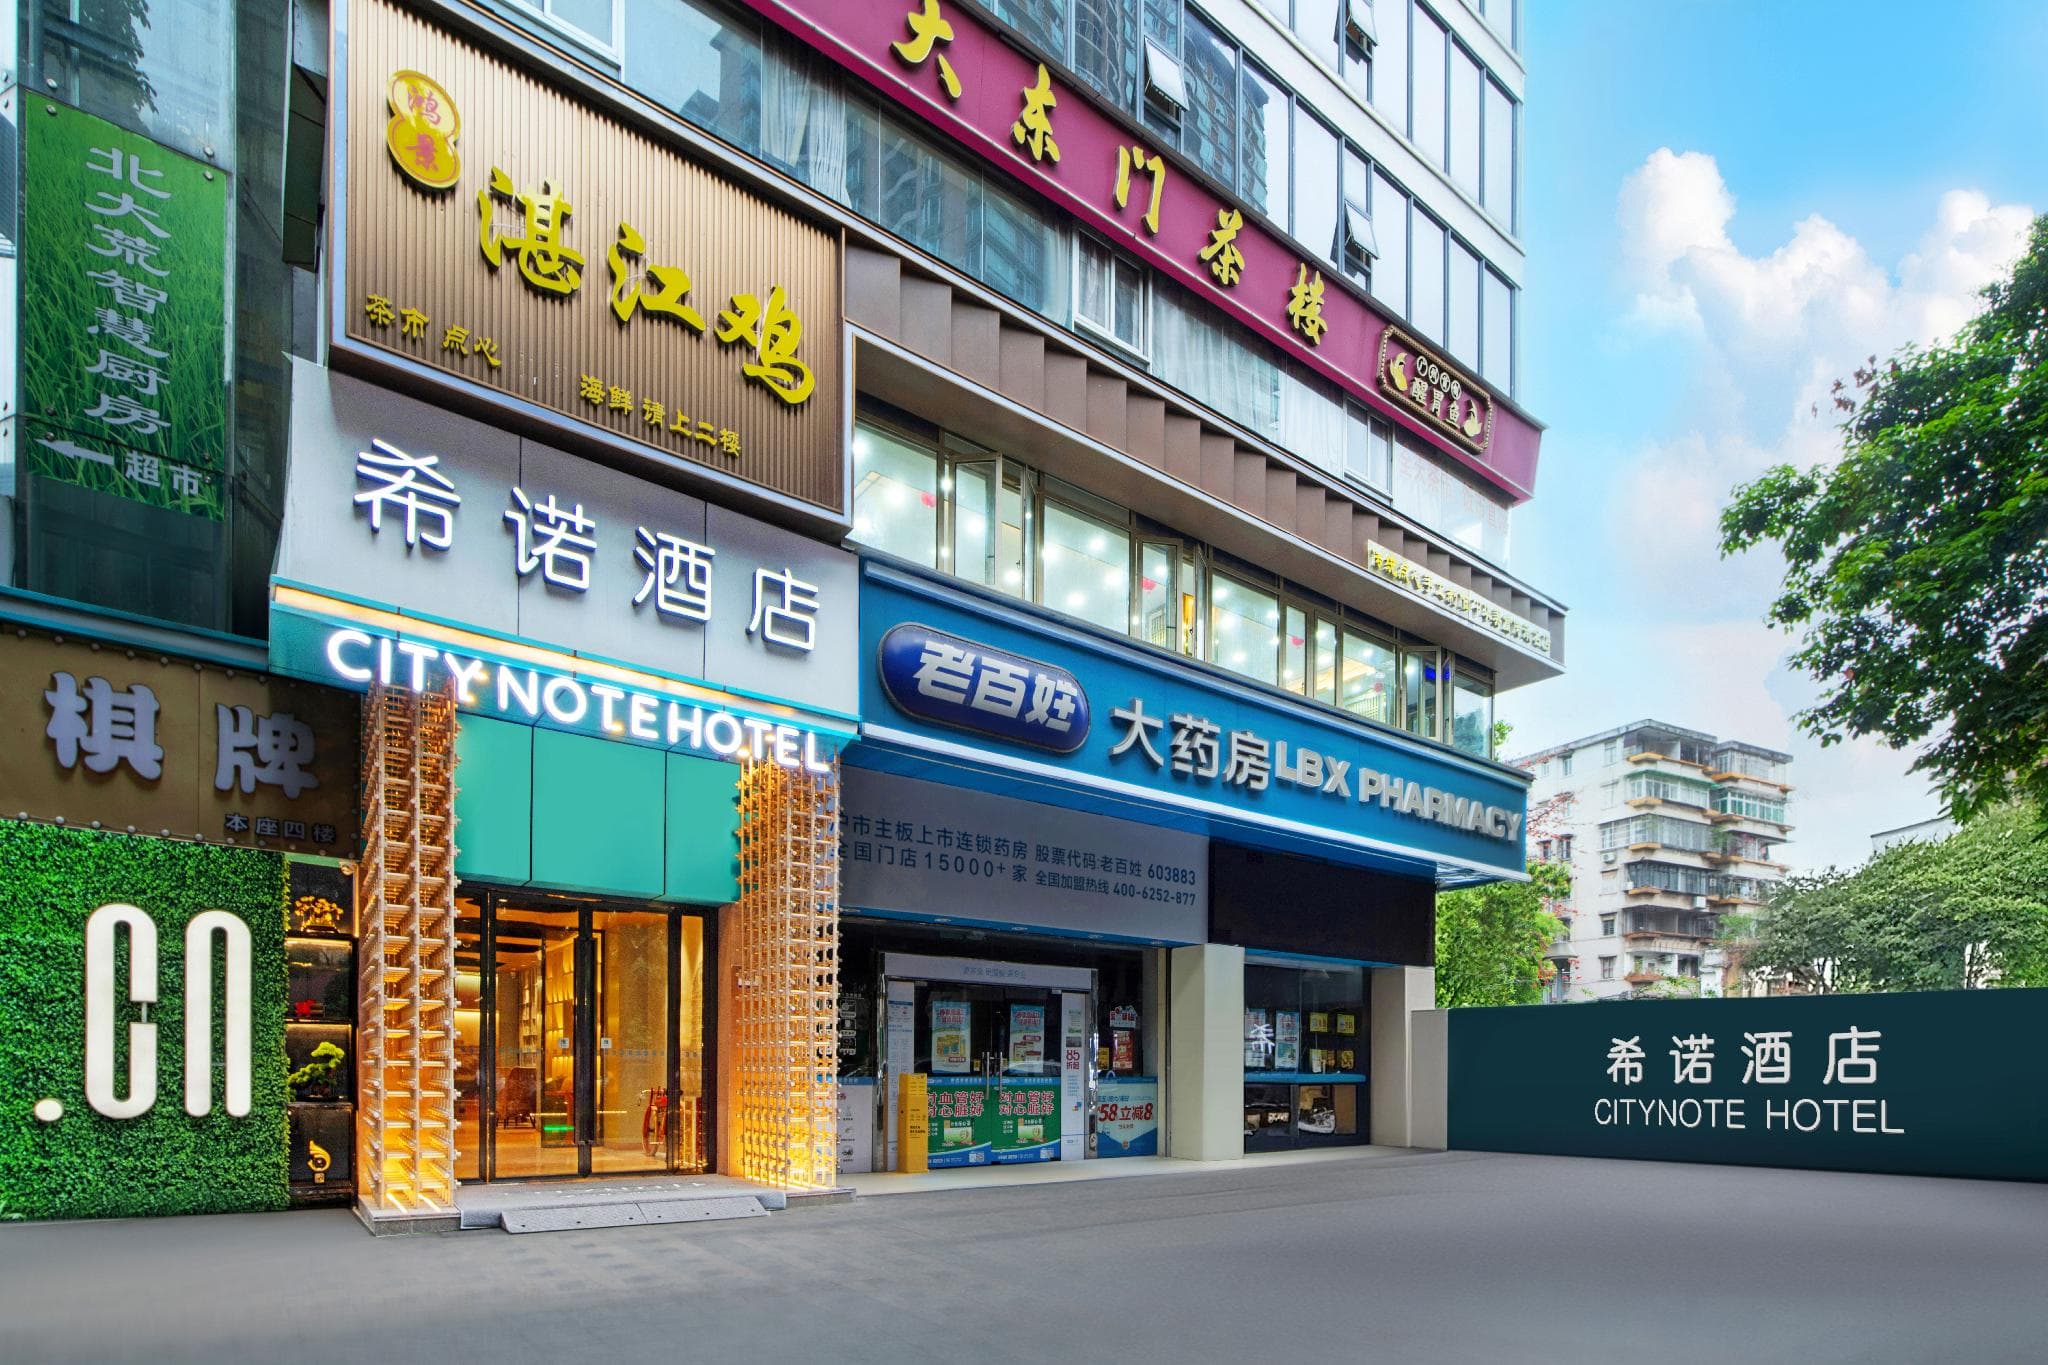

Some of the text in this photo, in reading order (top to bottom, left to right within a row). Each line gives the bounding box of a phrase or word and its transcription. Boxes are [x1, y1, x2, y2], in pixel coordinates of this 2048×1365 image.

[85, 146, 171, 435] 北大荒智慧厨房
[477, 165, 815, 405] 湛江鸡
[442, 323, 502, 367] 点心
[580, 373, 742, 458] 海鲜 请上二楼
[125, 450, 202, 496] 超市
[353, 438, 821, 652] 希诺酒店
[913, 640, 1078, 733] 老百姓
[44, 671, 320, 800] 棋牌
[667, 705, 831, 775] HOTEL
[1109, 697, 1272, 791] 大药房
[1275, 740, 1522, 841] LBX PHARMACY
[225, 812, 337, 843] 本座四楼
[1035, 870, 1110, 896] 全国加盟热线
[1113, 882, 1196, 906] 400-6252-877
[1147, 863, 1196, 886] 603883
[1066, 1049, 1080, 1061] 85
[1606, 1025, 1882, 1086] 希诺酒店
[1594, 1098, 1906, 1135] CITYNOTE HOTEL
